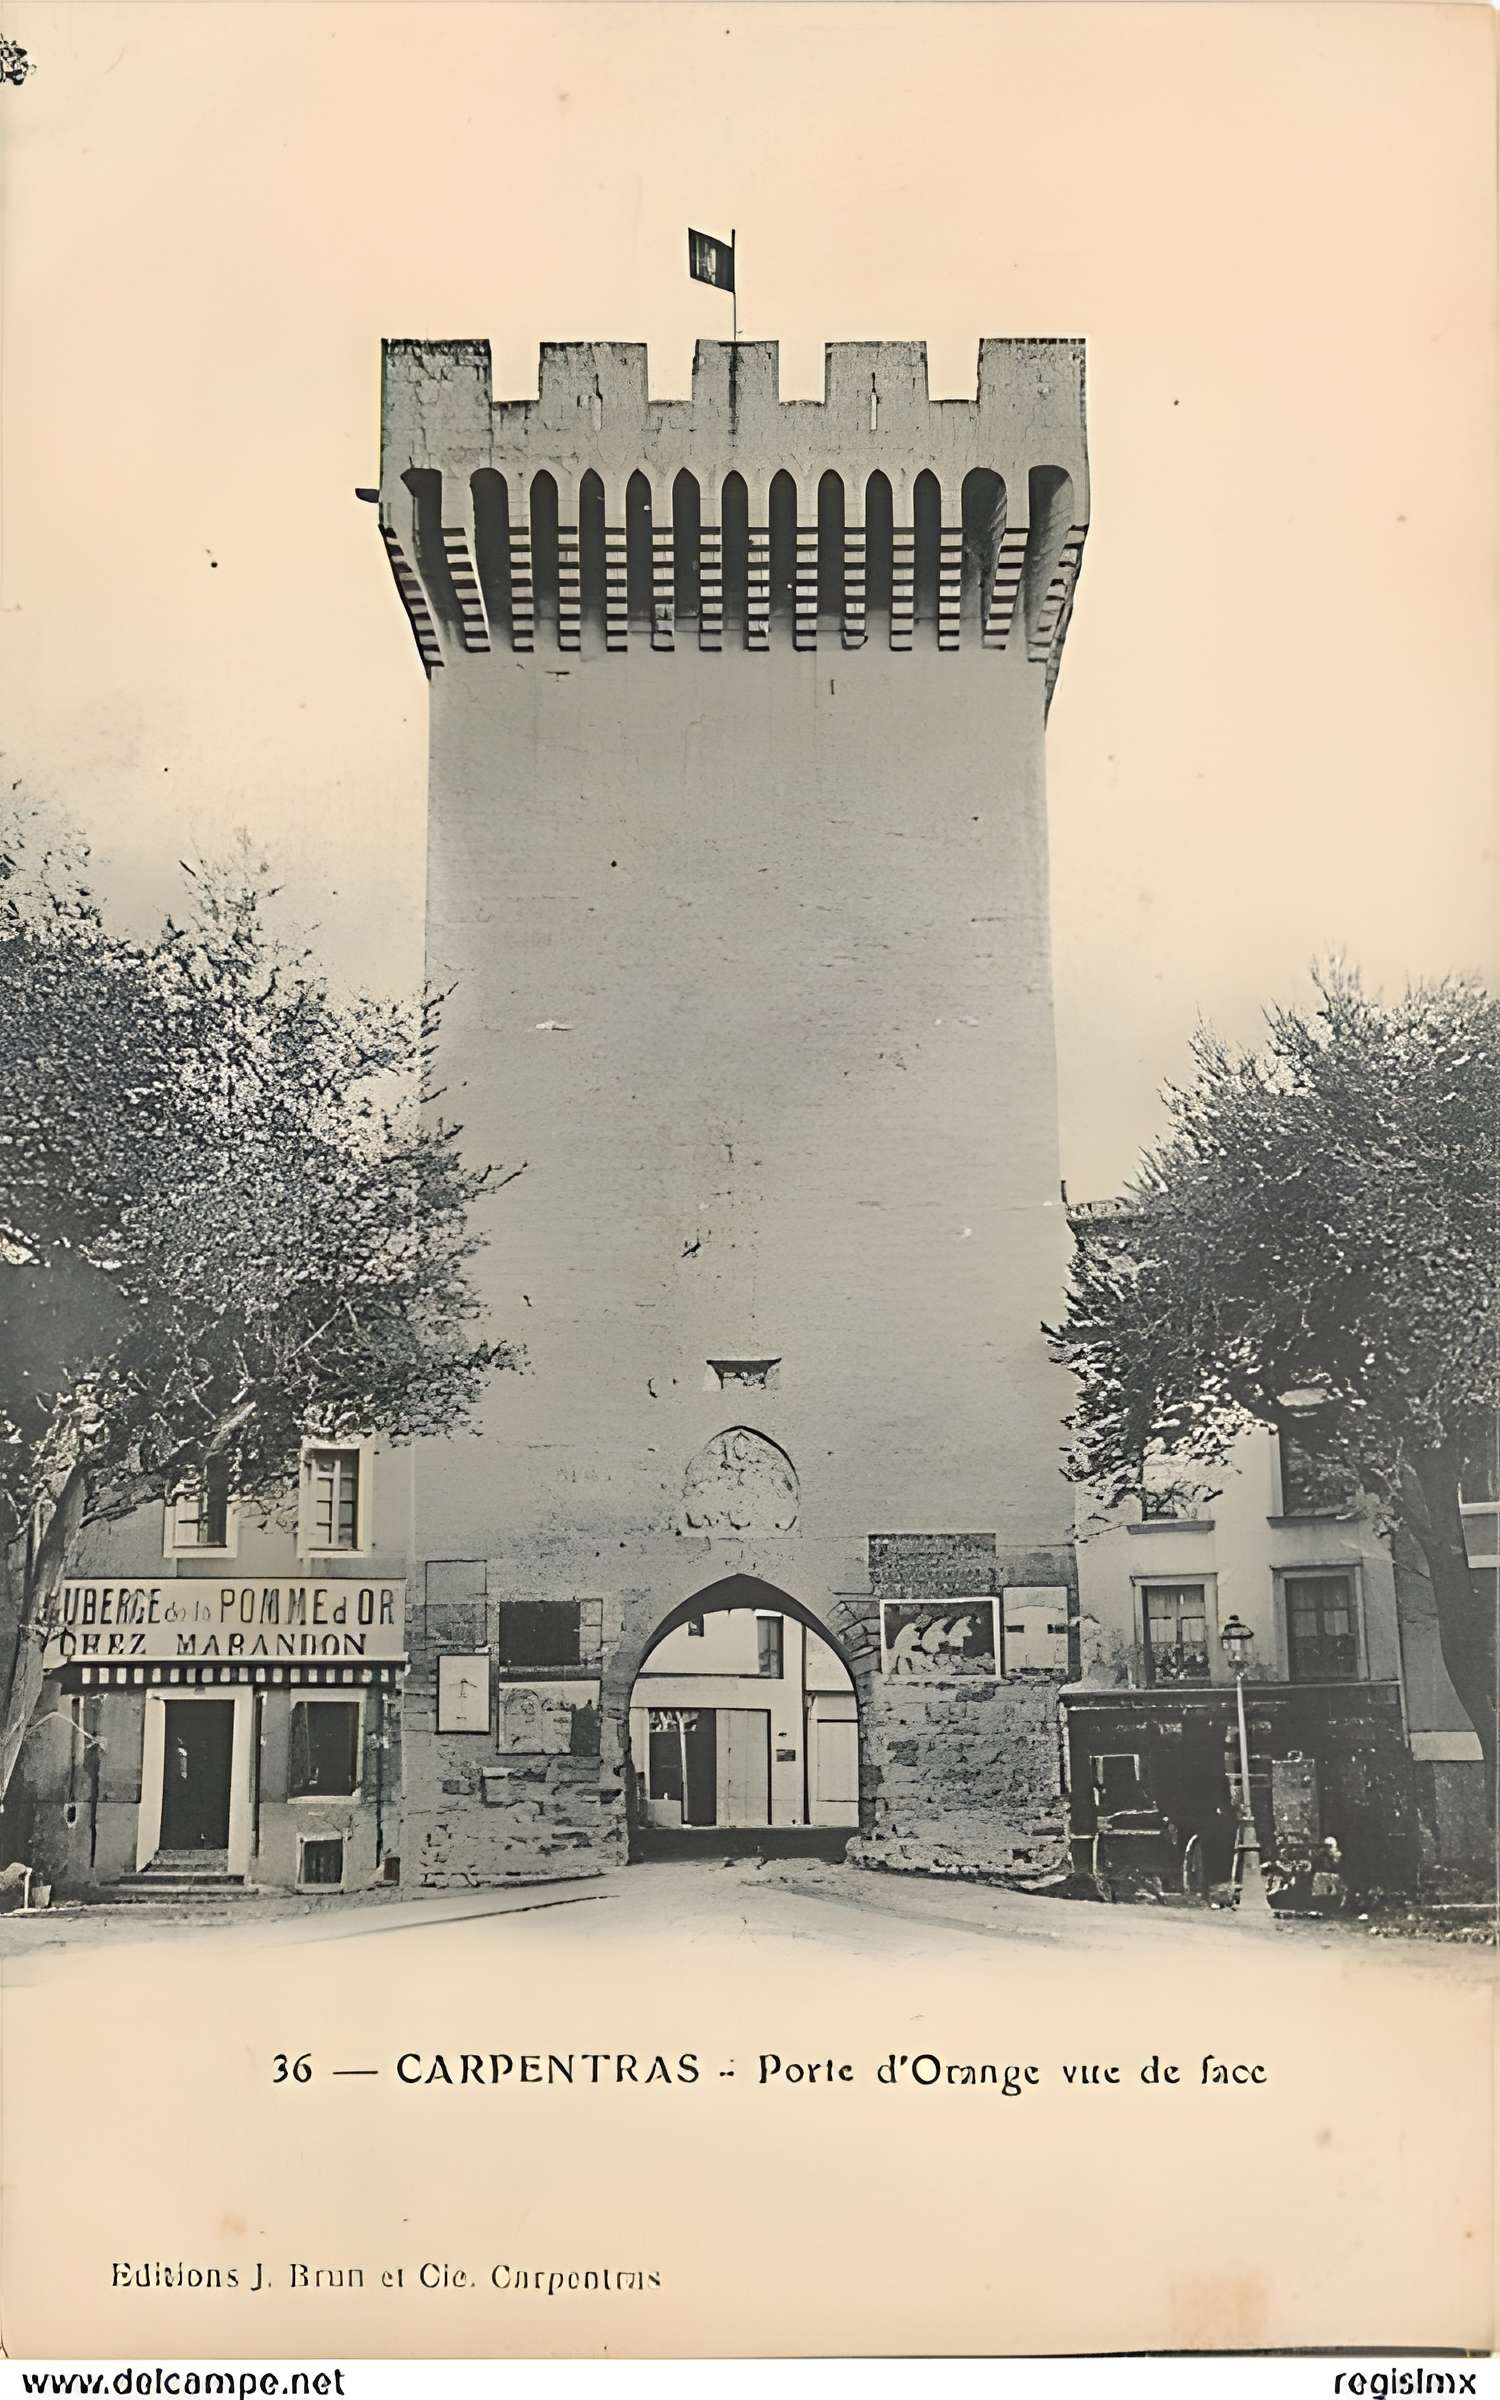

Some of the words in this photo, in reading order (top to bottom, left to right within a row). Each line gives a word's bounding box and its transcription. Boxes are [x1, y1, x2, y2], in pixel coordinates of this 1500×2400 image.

[63, 1588, 161, 1626] UBERGE
[220, 1588, 328, 1625] POMME
[60, 1632, 146, 1656] CHEZ
[176, 1633, 367, 1656] MARANDON
[272, 2052, 312, 2084] 36
[396, 2053, 700, 2085] CARPENTRAS
[758, 2054, 854, 2085] Porte
[877, 2054, 1040, 2097] d'Orange
[1062, 2064, 1121, 2085] vue
[1140, 2055, 1181, 2085] de
[1201, 2054, 1269, 2085] face
[112, 2261, 239, 2288] Editions
[250, 2262, 272, 2292] J.
[290, 2263, 364, 2288] Brun
[381, 2268, 404, 2288] et
[491, 2264, 662, 2296] Carpentras
